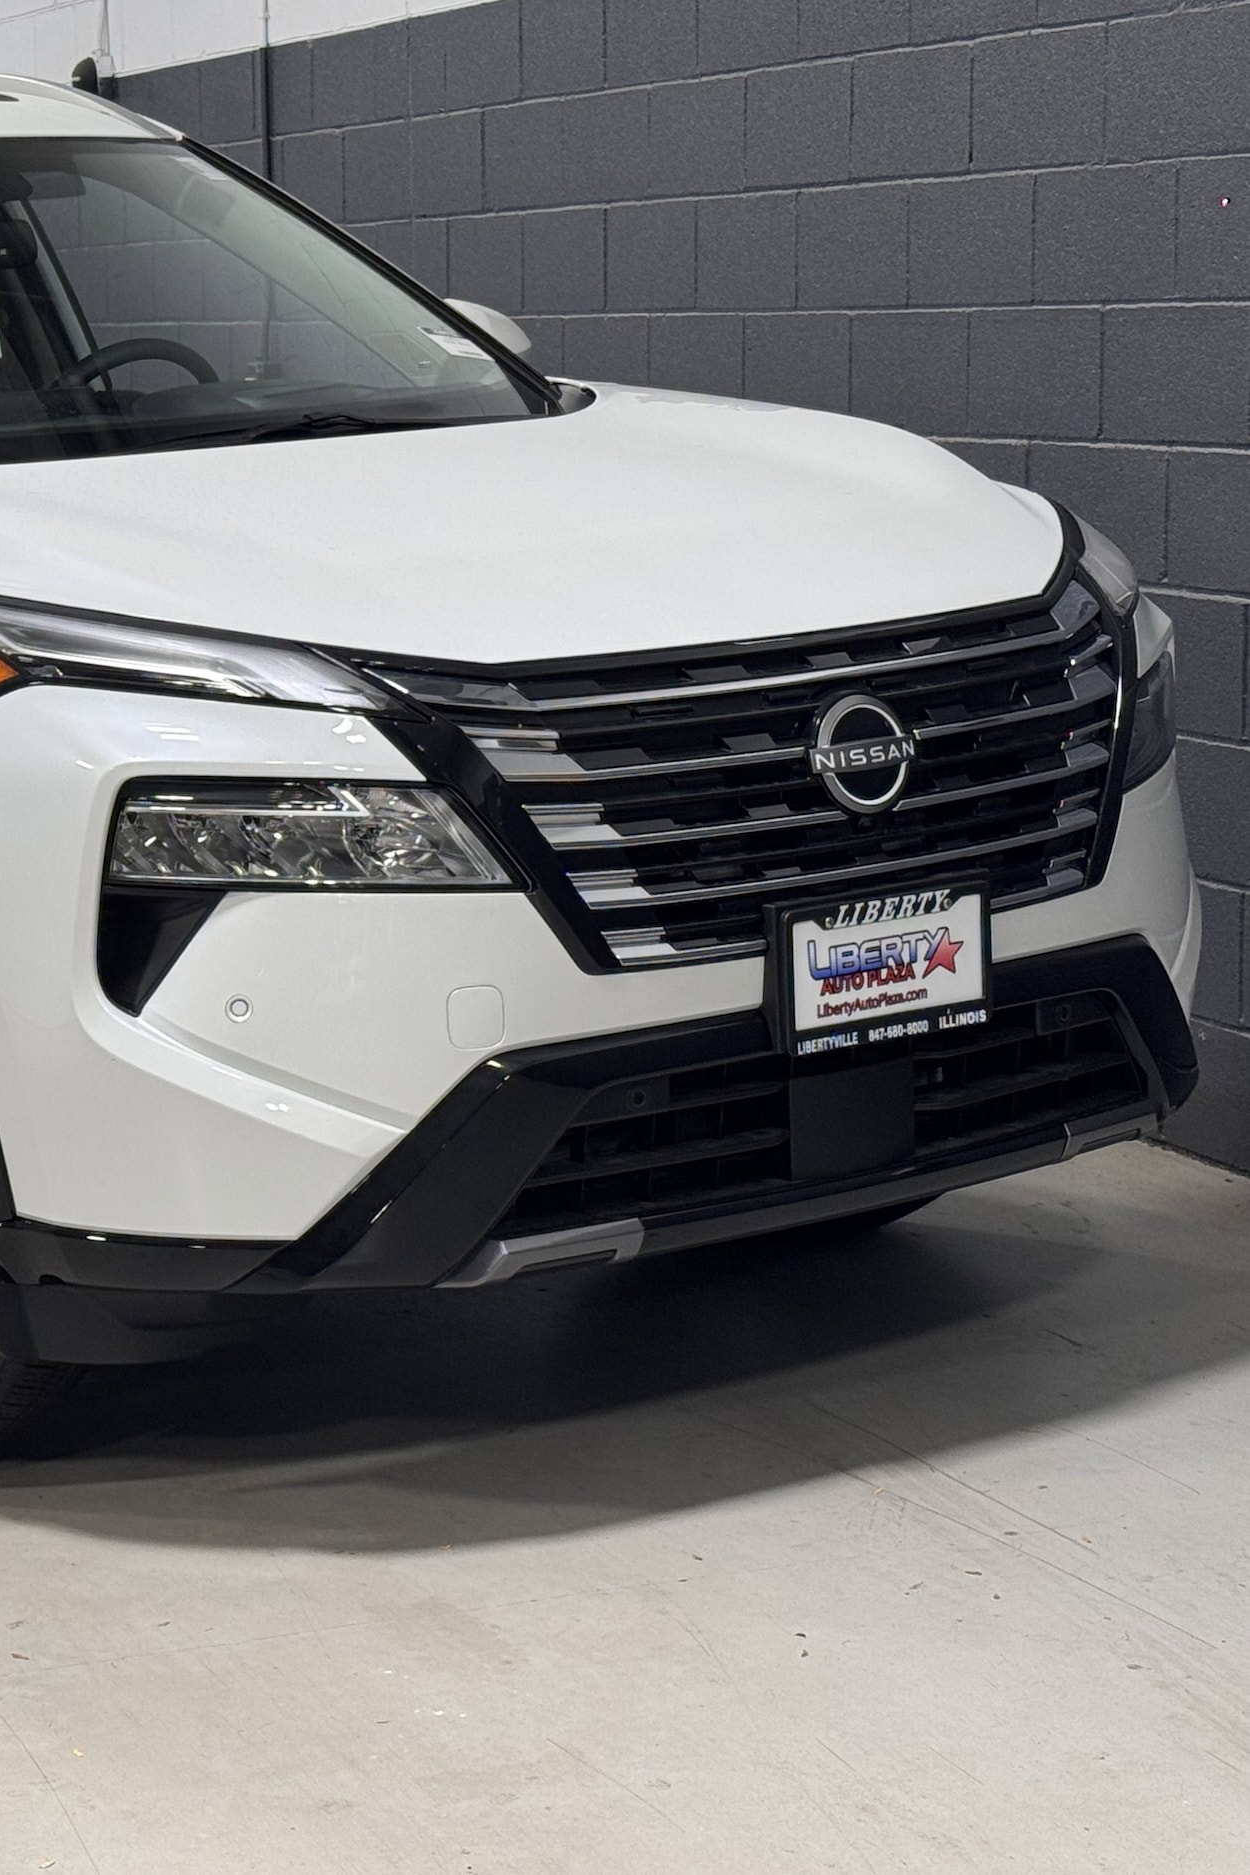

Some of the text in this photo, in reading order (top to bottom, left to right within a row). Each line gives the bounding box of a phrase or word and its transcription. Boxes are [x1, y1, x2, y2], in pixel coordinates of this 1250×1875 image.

[814, 739, 915, 770] NISSAN
[833, 889, 951, 929] LIBERTY
[807, 927, 949, 980] LIBERTY
[820, 962, 916, 996] AUTO PLAZA
[797, 1031, 859, 1056] LIBERTYVILLE
[938, 1009, 988, 1030] ILLINOIS
